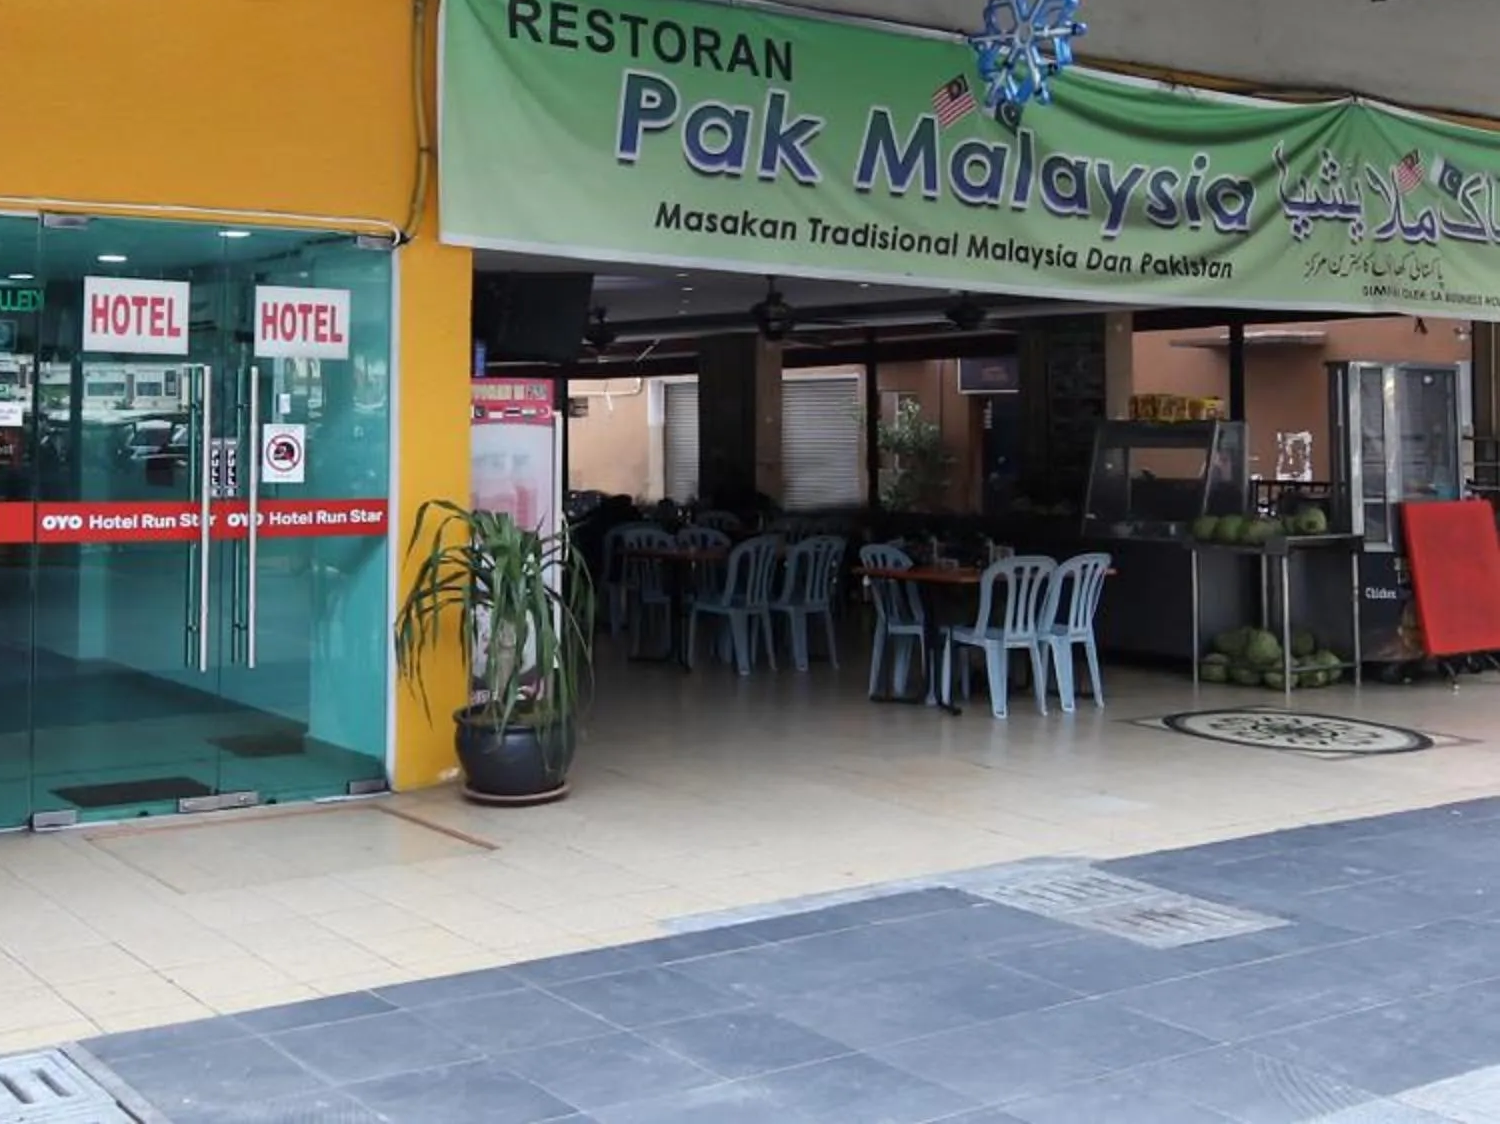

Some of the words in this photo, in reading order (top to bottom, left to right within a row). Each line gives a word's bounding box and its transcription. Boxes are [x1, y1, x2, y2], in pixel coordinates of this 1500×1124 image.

[615, 70, 825, 186] Pak
[853, 105, 1259, 243] Malaysia
[655, 201, 798, 242] Masakan
[807, 216, 959, 258] Tradisional
[967, 235, 1078, 271] Malaysia
[1086, 247, 1133, 274] Dan
[1140, 253, 1234, 280] Pakistan
[91, 294, 181, 337] HOTEL
[261, 302, 343, 344] HOTEL
[42, 515, 83, 530] OYO
[89, 514, 138, 530] Hotel
[141, 513, 176, 529] Run
[179, 512, 217, 527] Str
[269, 510, 313, 525] Hotel
[316, 509, 347, 524] Run
[350, 508, 383, 523] Star
